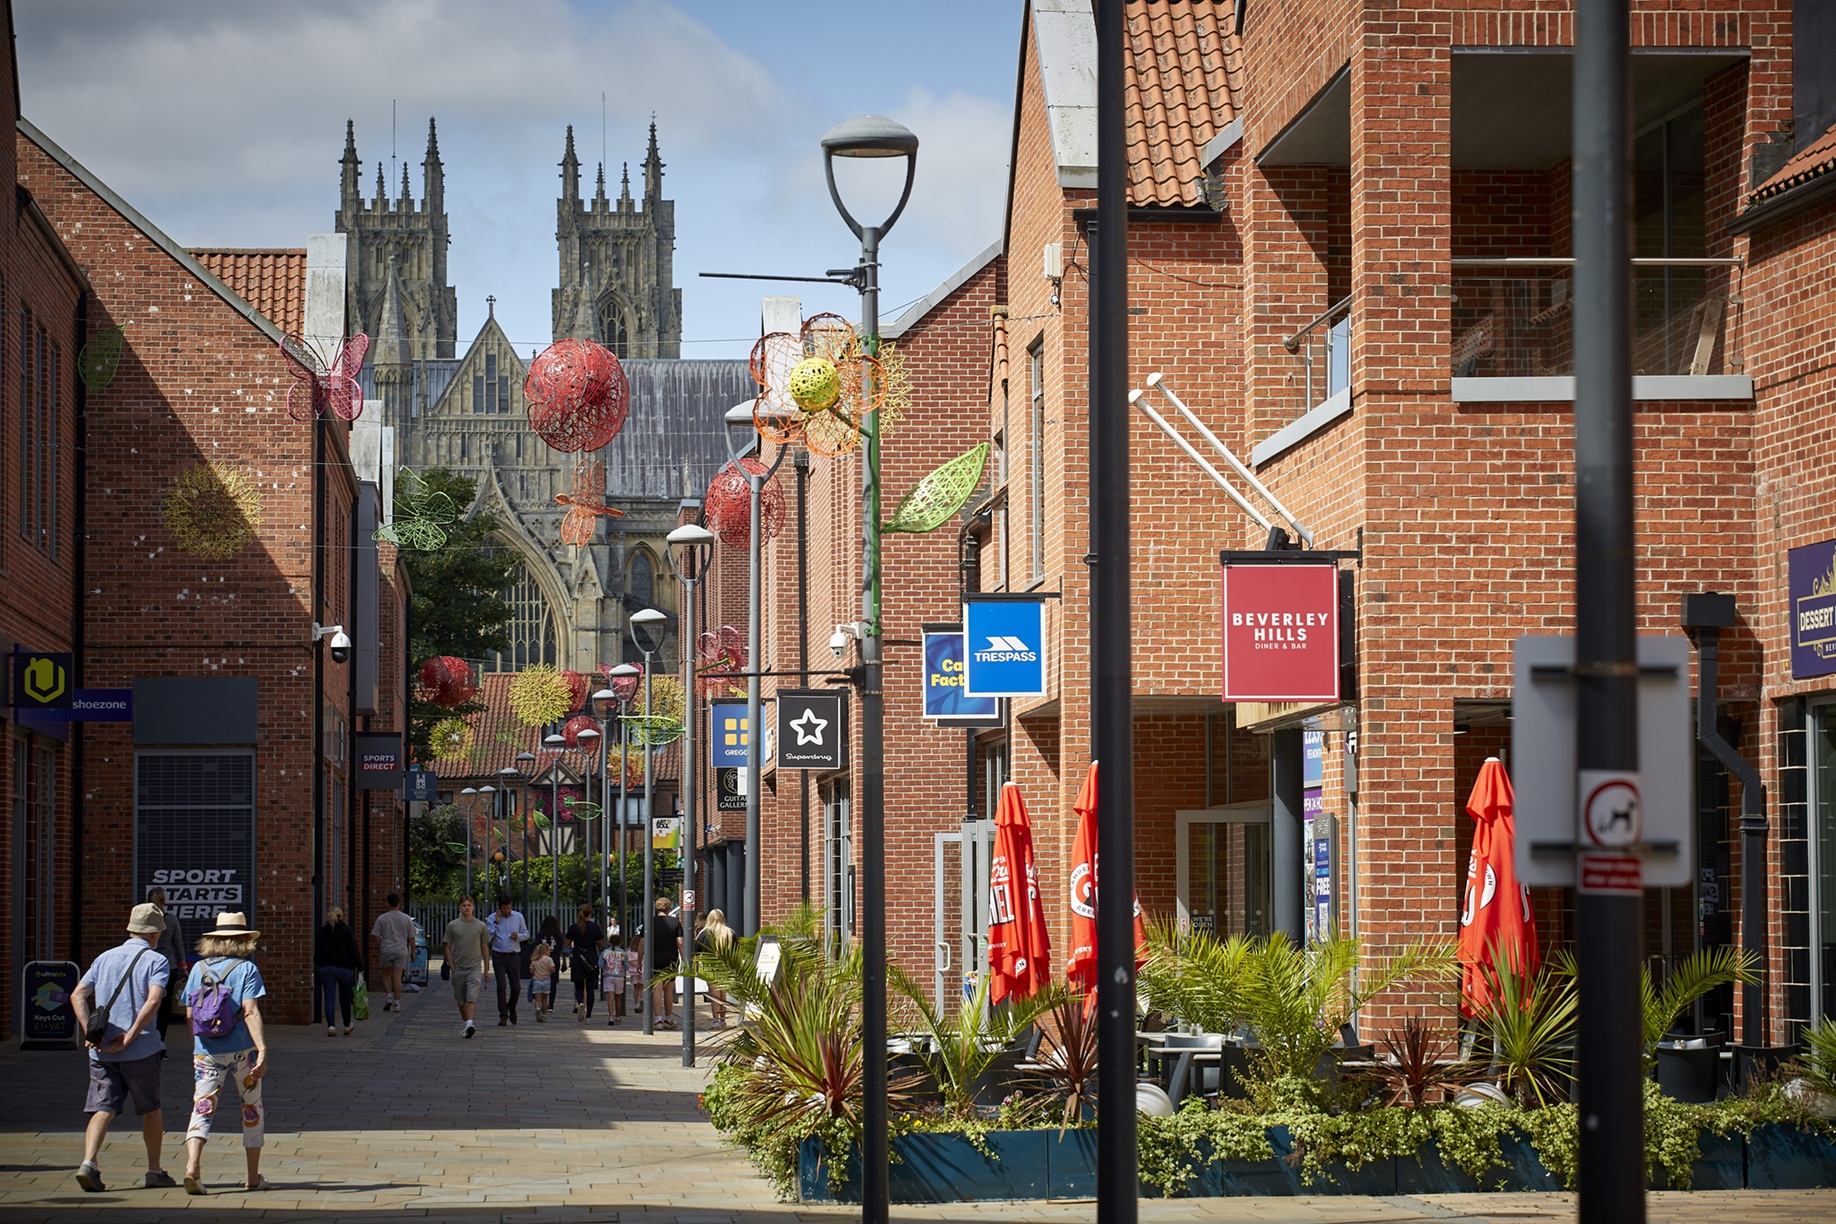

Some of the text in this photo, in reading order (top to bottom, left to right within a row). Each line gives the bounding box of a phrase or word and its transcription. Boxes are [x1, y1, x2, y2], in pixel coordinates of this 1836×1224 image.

[1232, 613, 1329, 626] BEVERLEY
[1800, 605, 1834, 631] DESSERT
[1254, 628, 1307, 641] HILLS
[973, 651, 1037, 662] TRESPASS
[941, 658, 963, 672] Ca
[931, 673, 964, 687] Fact
[72, 699, 127, 710] shoezone
[363, 754, 396, 762] SPORTS
[785, 752, 833, 762] Superdrug
[720, 801, 748, 809] GALLER
[152, 869, 237, 884] SPORT
[1316, 877, 1330, 896] FREE
[163, 887, 239, 901] TARTS
